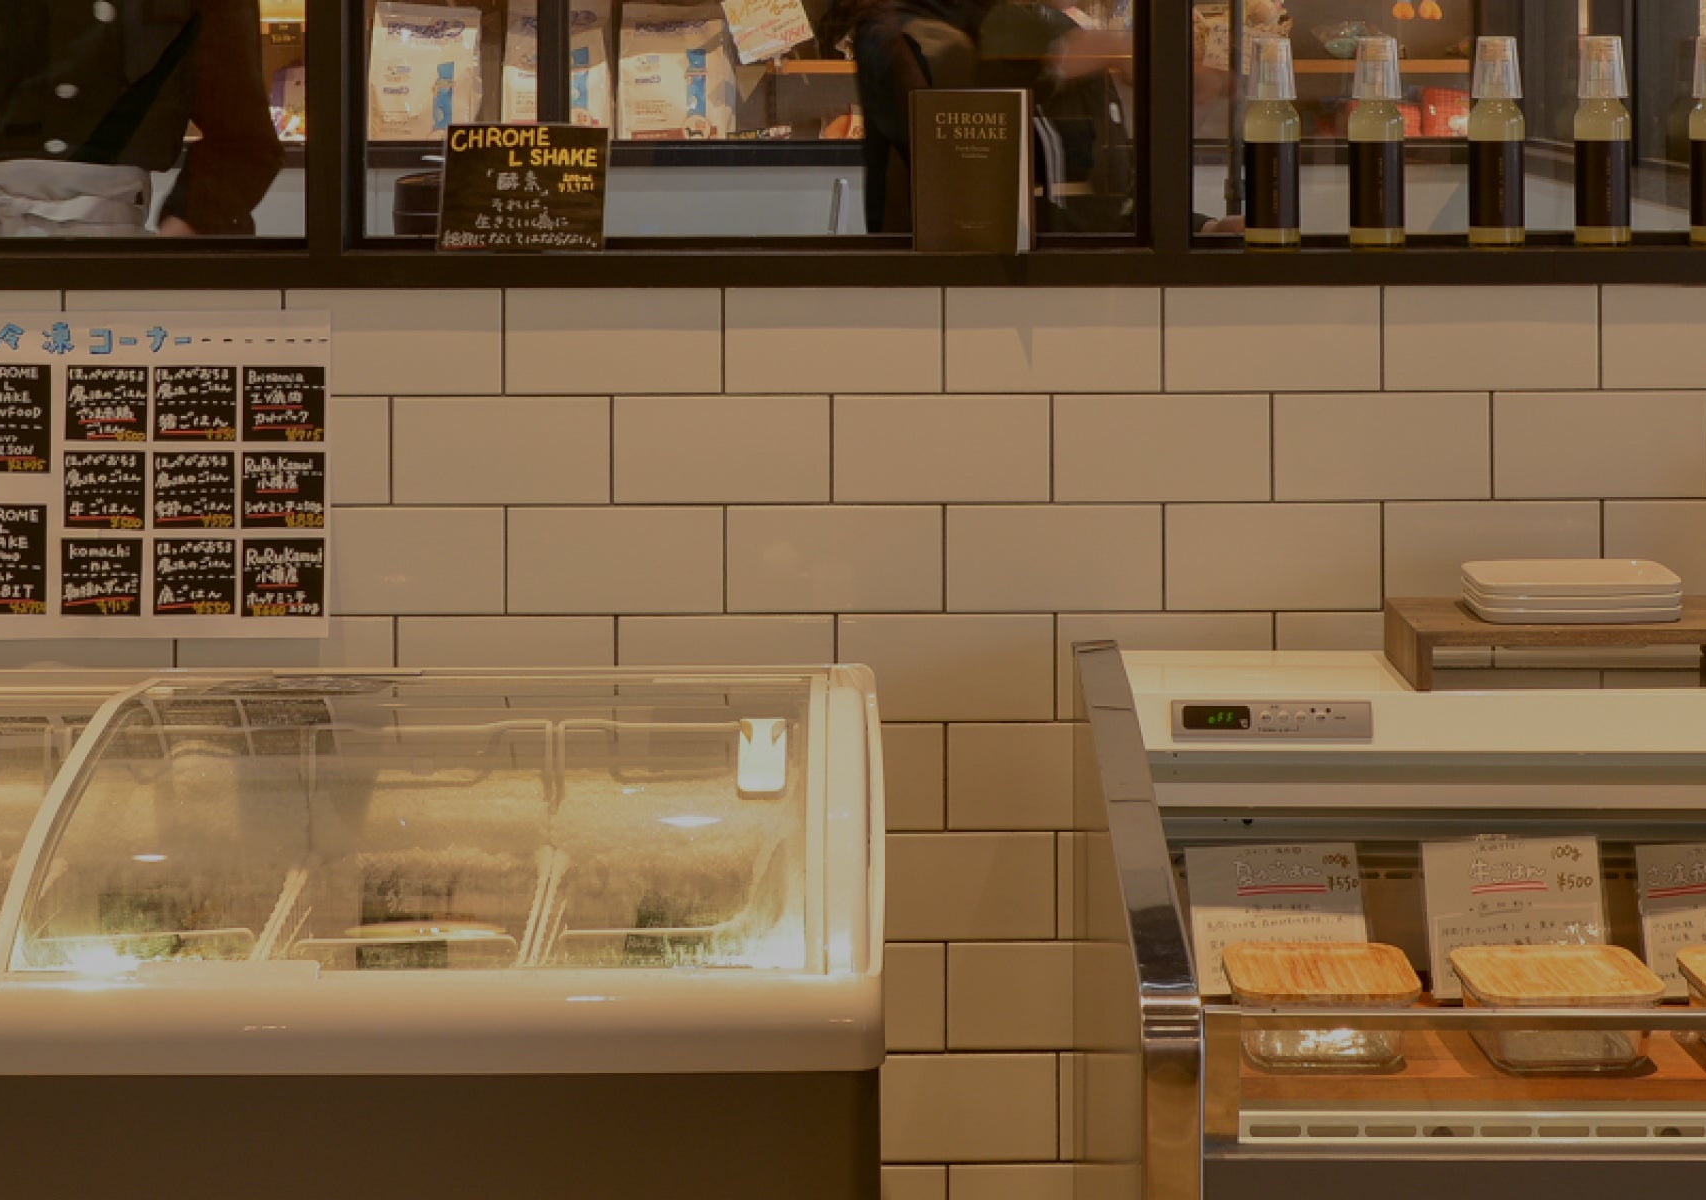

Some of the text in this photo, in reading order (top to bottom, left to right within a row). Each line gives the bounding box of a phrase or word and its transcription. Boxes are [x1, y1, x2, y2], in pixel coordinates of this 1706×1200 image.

[935, 112, 1008, 126] CHROME
[451, 127, 551, 152] CHROME
[936, 127, 1009, 139] L SHAKE
[509, 148, 598, 168] L SHAKE
[3, 381, 15, 391] L
